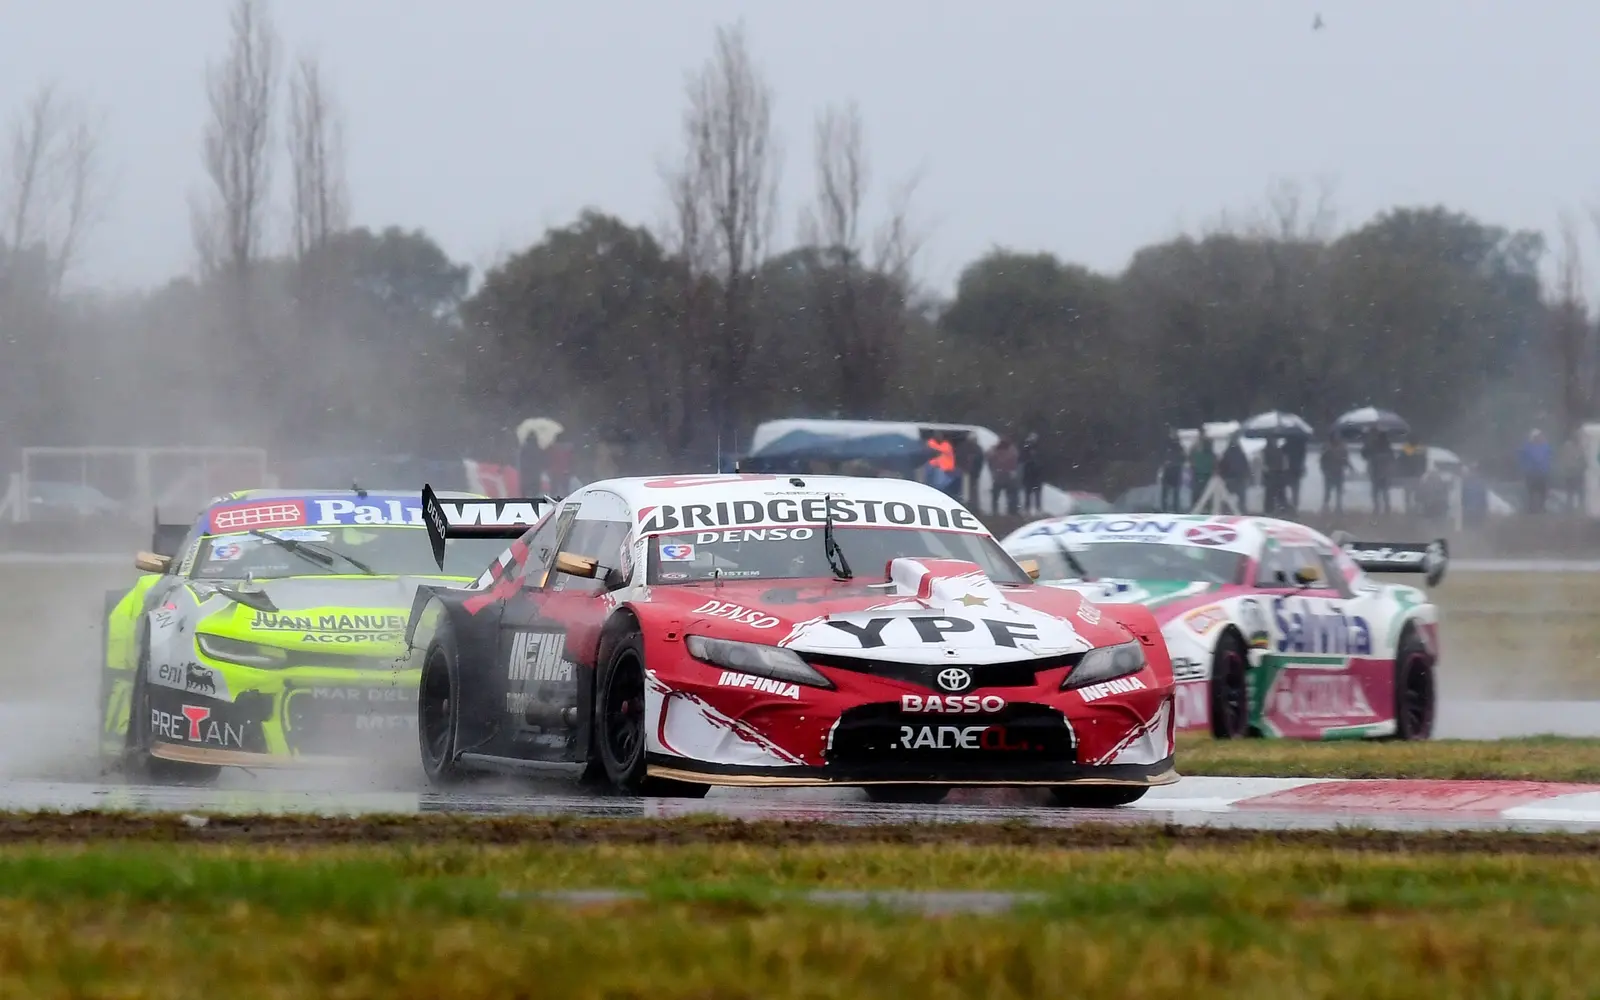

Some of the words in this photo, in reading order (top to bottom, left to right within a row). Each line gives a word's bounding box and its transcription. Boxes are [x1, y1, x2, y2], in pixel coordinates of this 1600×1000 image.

[427, 498, 446, 540] DENSO
[440, 503, 553, 525] VIA
[639, 498, 979, 534] BRIDGESTONE
[696, 527, 814, 545] DENSO
[1022, 520, 1177, 540] AXION
[251, 612, 312, 631] JUAN
[692, 600, 779, 629] DENSO
[826, 615, 1040, 650] YPF
[158, 662, 184, 684] eni
[313, 687, 360, 700] MAR
[718, 671, 800, 700] INFINIA
[1077, 676, 1147, 703] INFINIA
[902, 694, 1005, 713] BASSO
[151, 704, 244, 748] PRETAN
